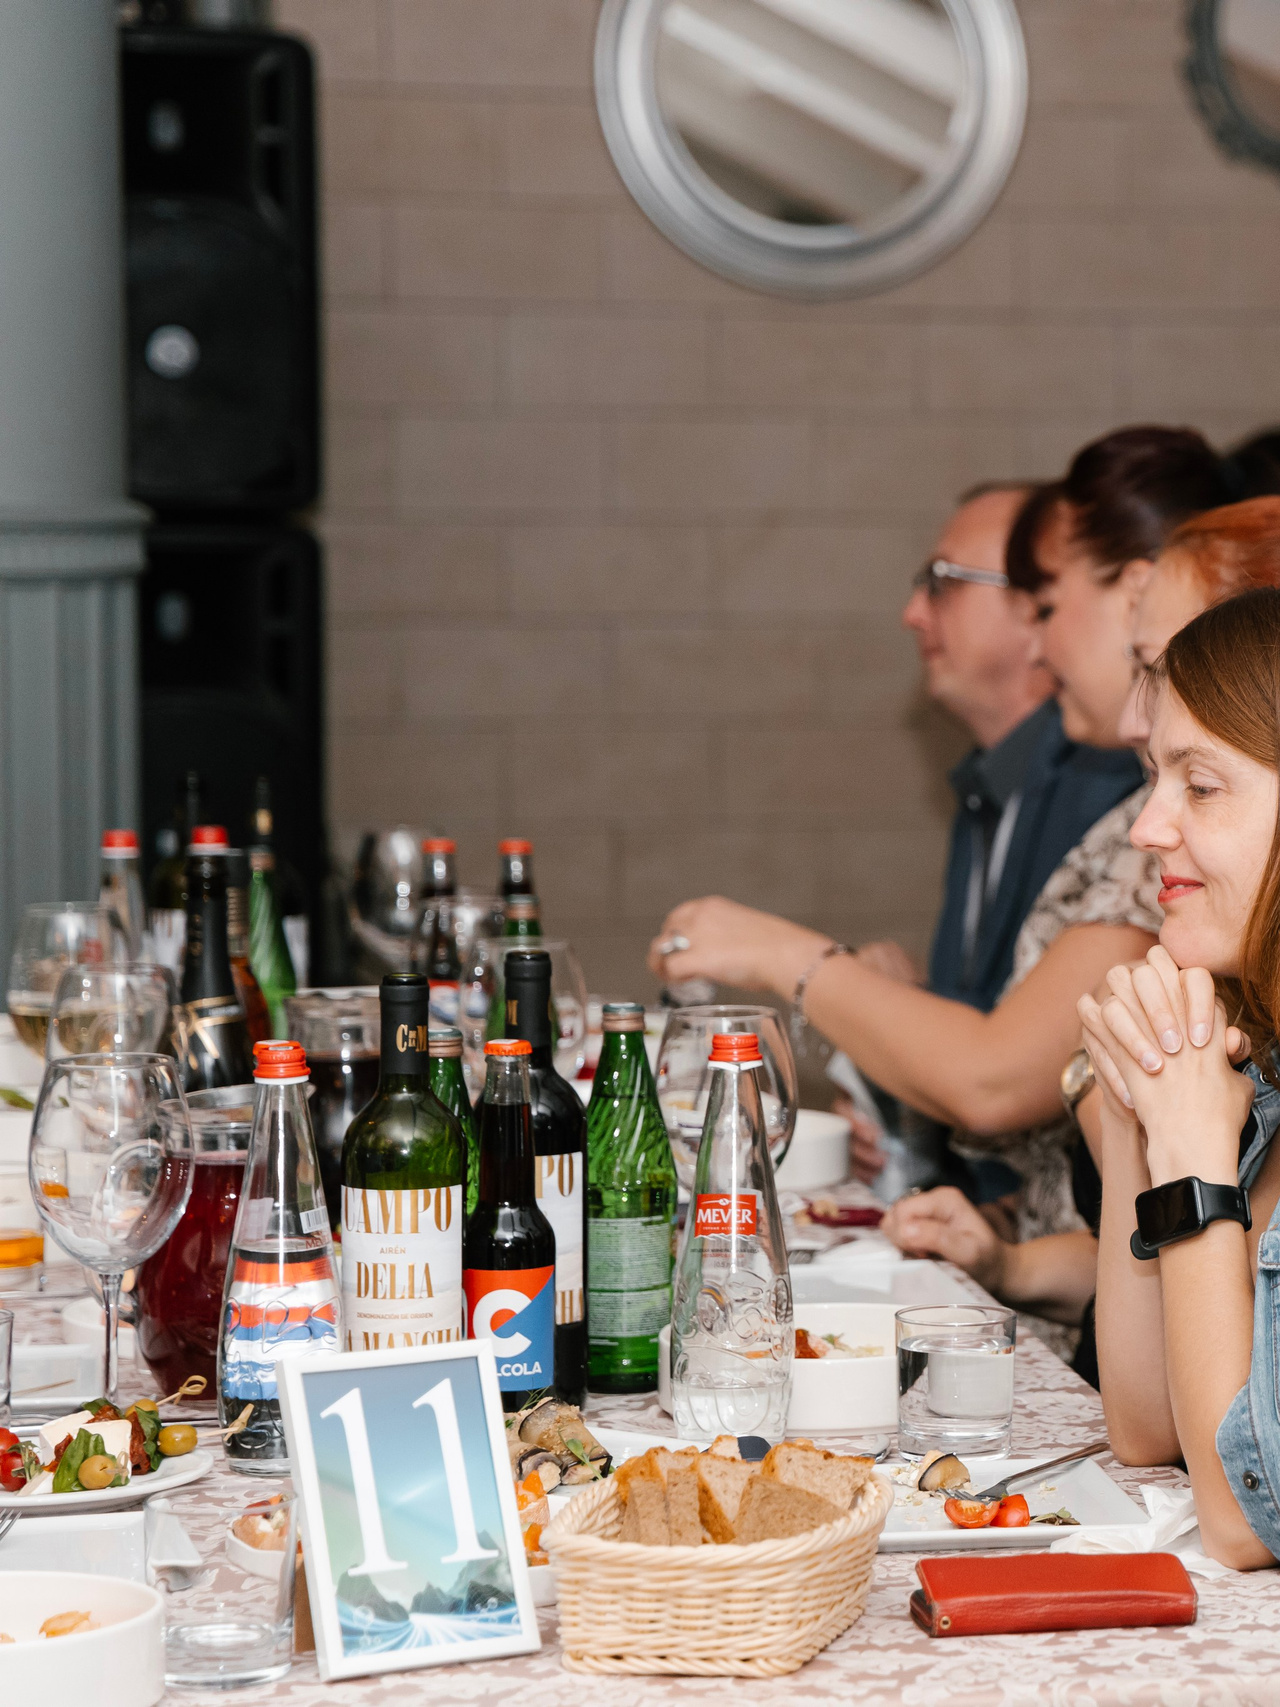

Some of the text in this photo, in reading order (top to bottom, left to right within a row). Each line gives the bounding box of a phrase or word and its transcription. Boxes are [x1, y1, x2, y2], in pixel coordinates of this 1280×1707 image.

[344, 1186, 452, 1235] CAMPO
[696, 1208, 753, 1224] MEVER
[380, 1246, 406, 1255] AIRÉN
[319, 1377, 500, 1577] 11
